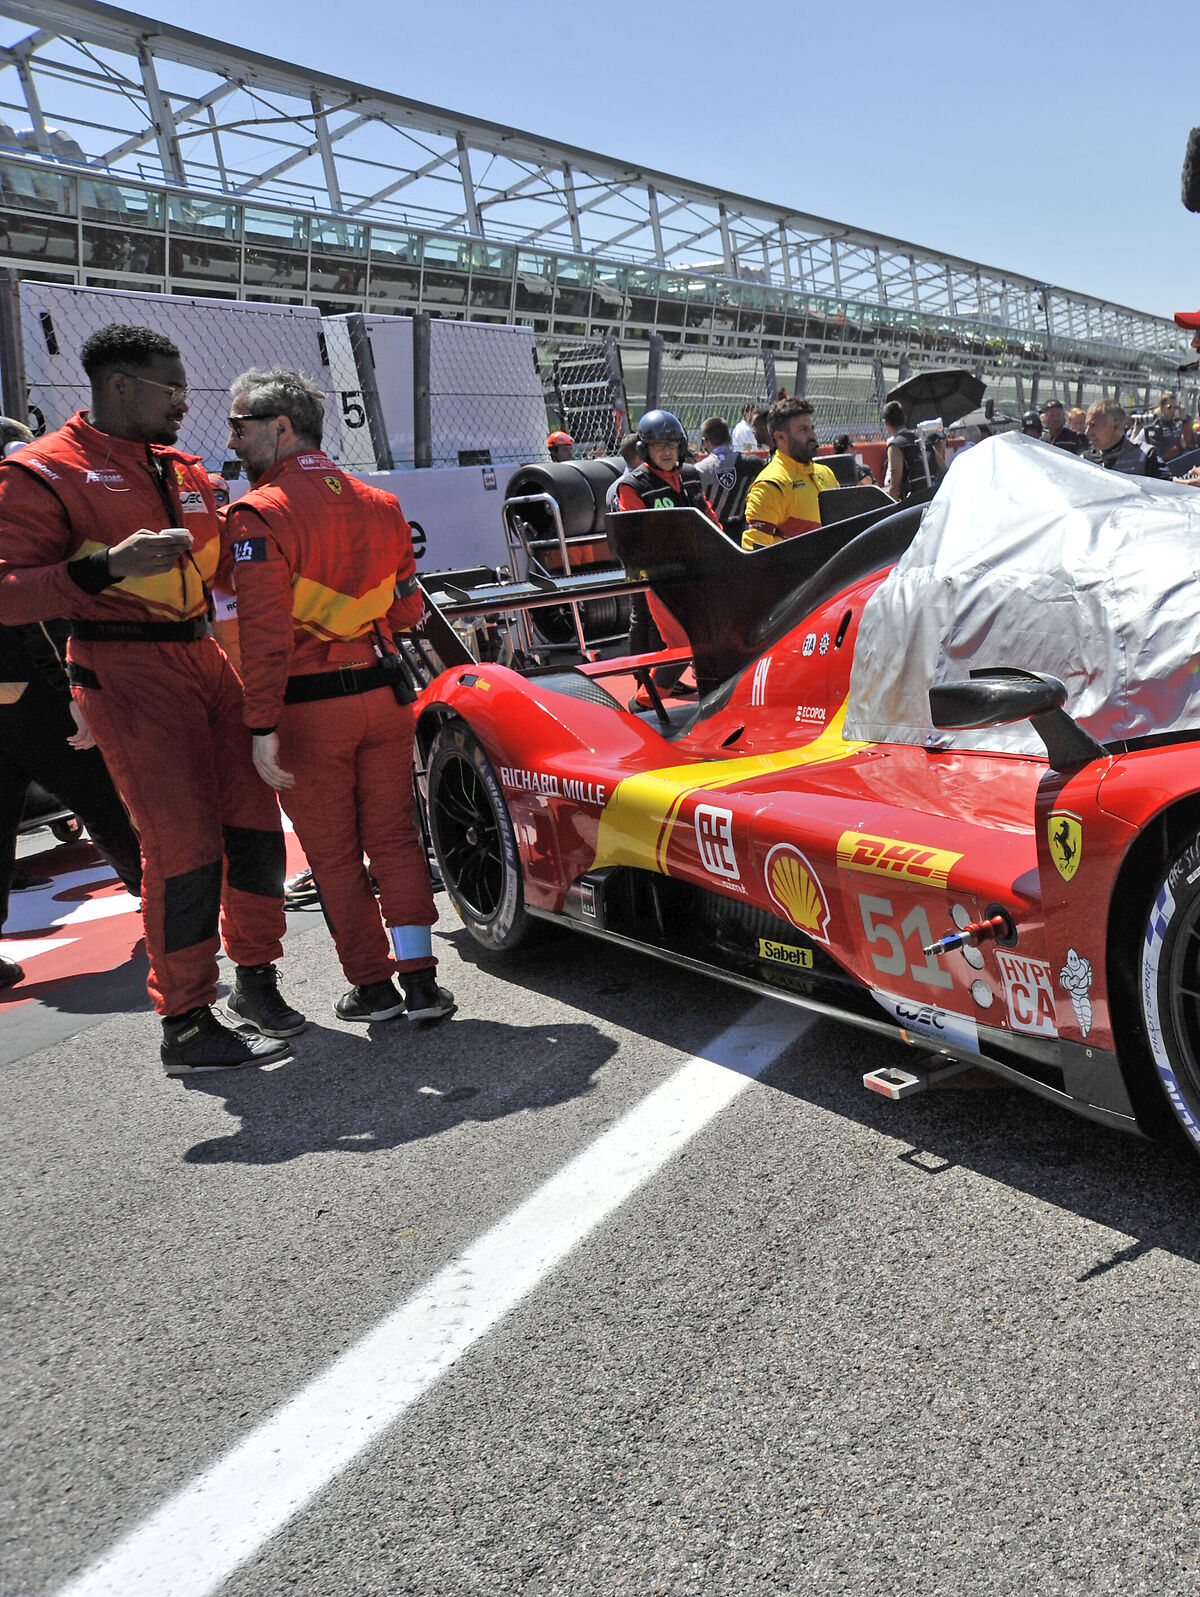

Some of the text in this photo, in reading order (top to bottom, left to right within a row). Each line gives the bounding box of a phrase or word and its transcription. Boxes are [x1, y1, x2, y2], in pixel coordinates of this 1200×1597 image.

[341, 391, 366, 429] 5
[802, 706, 826, 720] ECOPOL
[501, 766, 606, 807] RICHARD MILLE
[849, 838, 937, 878] DHL
[764, 941, 807, 967] Sabelt
[857, 892, 955, 991] 51
[895, 1004, 946, 1029] WEC
